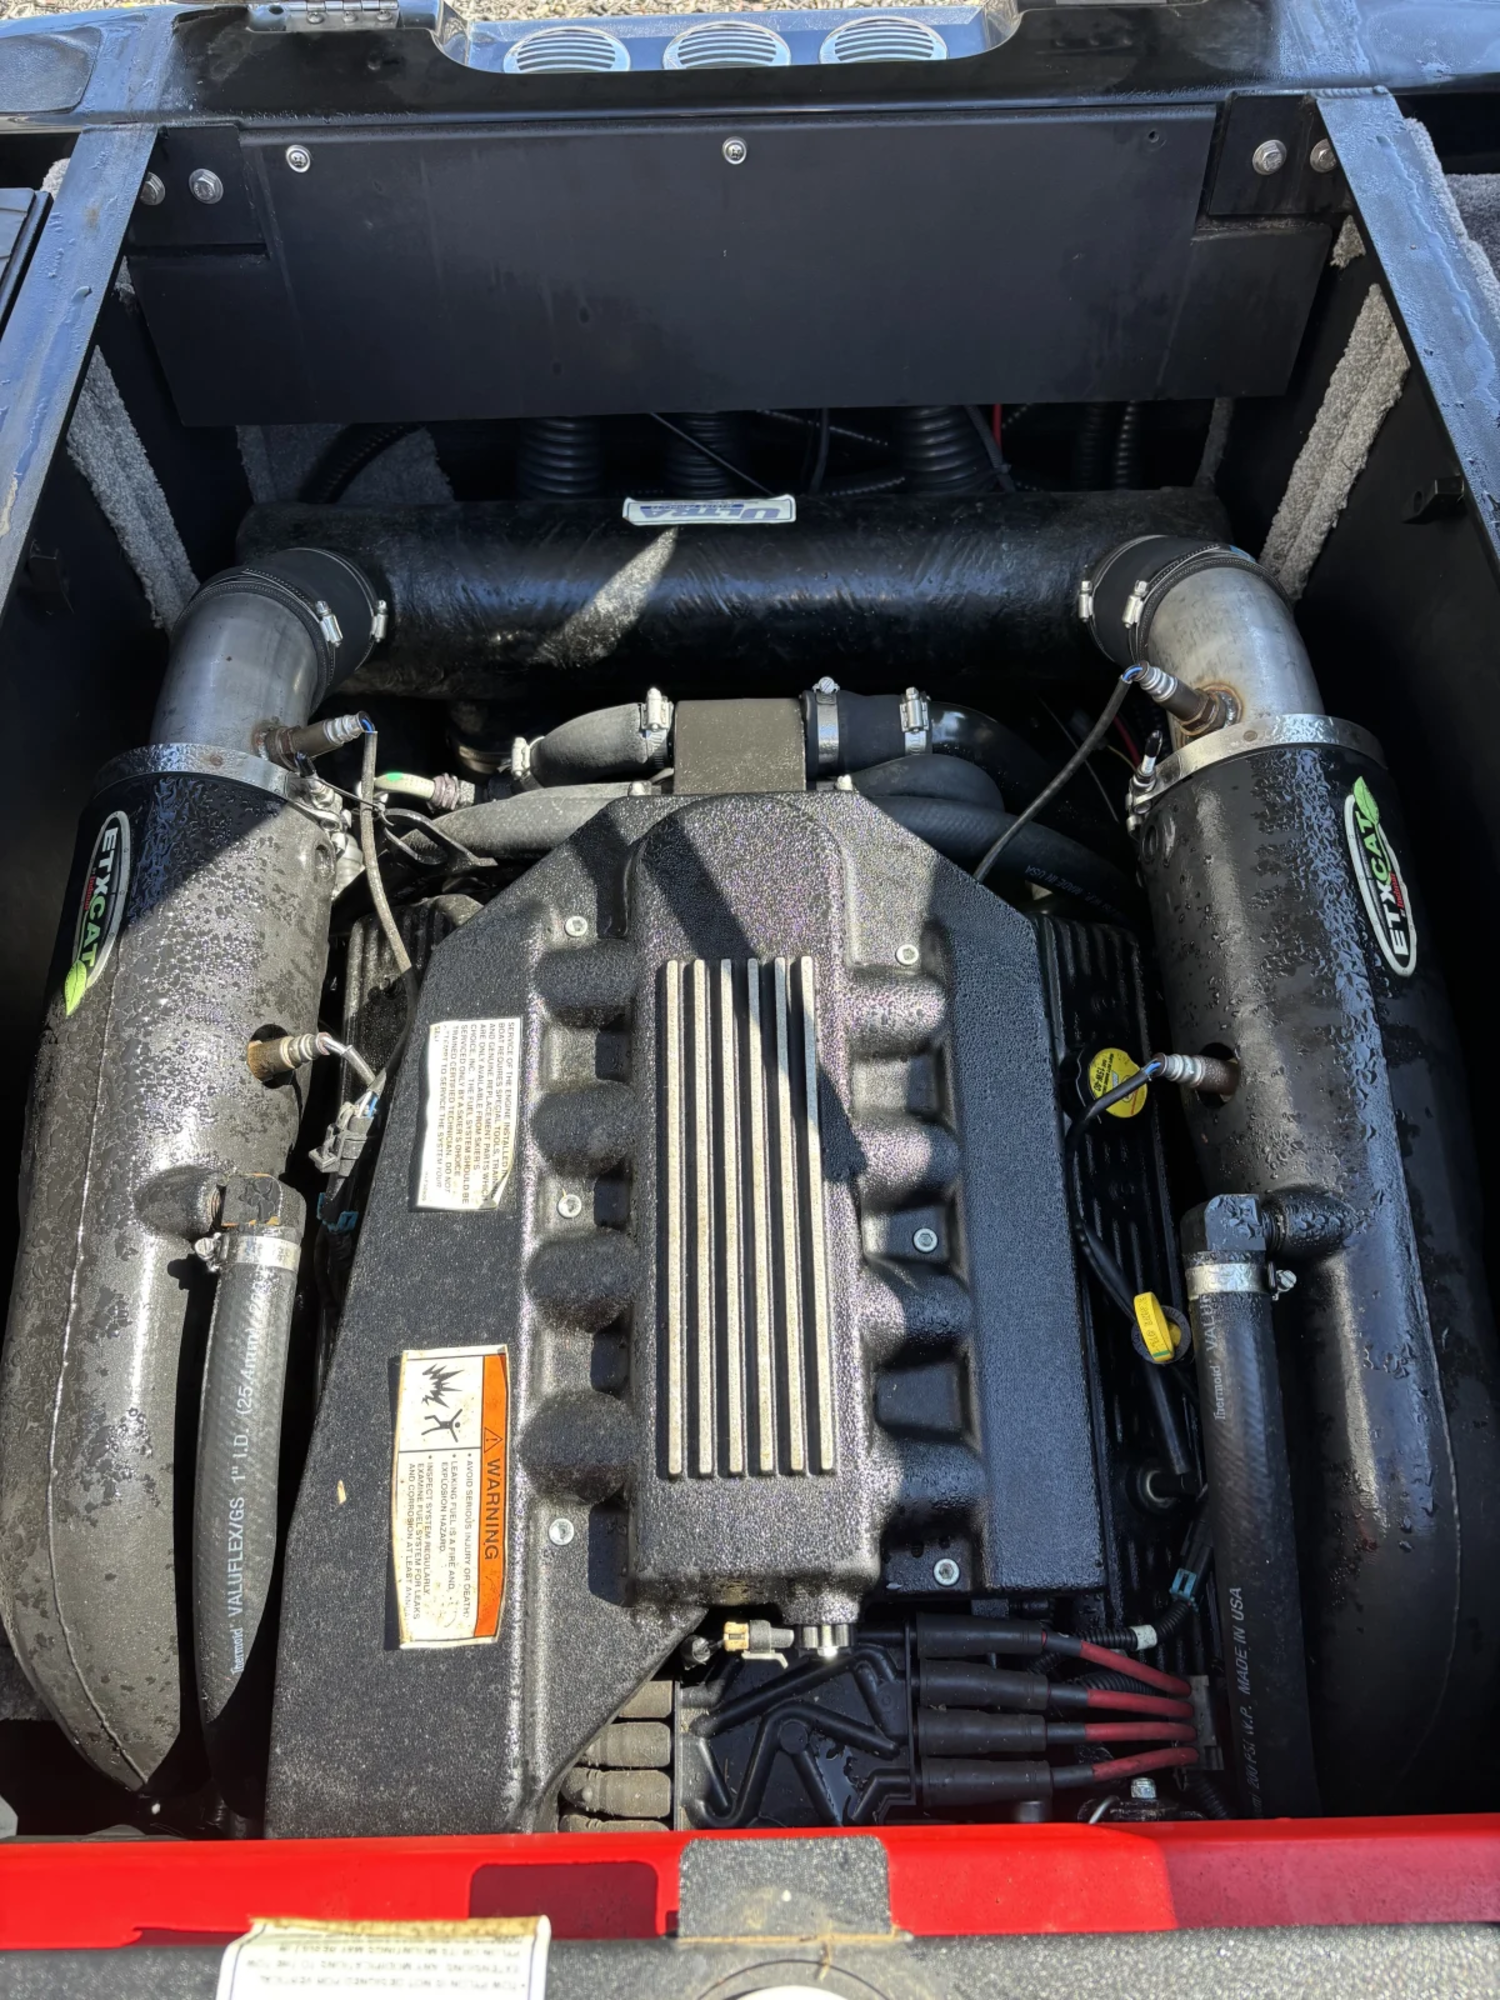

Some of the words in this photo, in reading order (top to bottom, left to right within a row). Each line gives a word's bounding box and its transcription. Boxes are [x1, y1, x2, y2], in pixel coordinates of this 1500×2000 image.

[640, 507, 780, 519] ULTRA
[1025, 865, 1046, 878] USA
[451, 1026, 459, 1059] TRAINED
[459, 1025, 468, 1064] SERVICED
[507, 1022, 515, 1056] SERVICE
[441, 1064, 447, 1074] TO
[496, 1046, 504, 1087] REQUIRES
[505, 1072, 513, 1088] THE
[506, 1058, 513, 1069] OF
[439, 1077, 447, 1111] SERVICE
[448, 1061, 456, 1103] CERTIFIED
[457, 1089, 464, 1101] BY
[476, 1065, 484, 1109] AVAILABLE
[437, 1114, 445, 1130] THE
[466, 1096, 474, 1118] FUEL
[475, 1111, 483, 1134] FROM
[484, 1080, 493, 1143] REPLACEMENT
[455, 1110, 463, 1142] SKIER'S
[436, 1132, 444, 1165] SYSTEM
[473, 1137, 481, 1170] SKIER'S
[502, 1122, 510, 1167] INSTALLED
[435, 1167, 443, 1188] YOUR
[463, 1155, 471, 1190] SHOULD
[462, 1192, 469, 1204] BE
[1210, 1365, 1226, 1420] Thermoid
[232, 1428, 249, 1459] I.D.
[440, 1462, 448, 1512] EXPLOSION
[450, 1461, 458, 1500] LEAKING
[407, 1484, 415, 1539] CORROSION
[464, 1490, 472, 1530] SERIOUS
[485, 1458, 501, 1560] WARNING
[406, 1542, 413, 1553] AT
[415, 1530, 423, 1566] SYSTEM
[439, 1515, 447, 1553] HAZARD.
[449, 1527, 456, 1536] IS
[228, 1496, 245, 1617] VALUFLEX/GS
[423, 1541, 431, 1595] REGULARLY.
[448, 1547, 456, 1568] FIRE
[463, 1568, 471, 1581] OR
[413, 1590, 421, 1619] LEAKS
[1229, 1587, 1245, 1621] USA
[1232, 1625, 1247, 1644] IN
[1234, 1645, 1251, 1695] MADE
